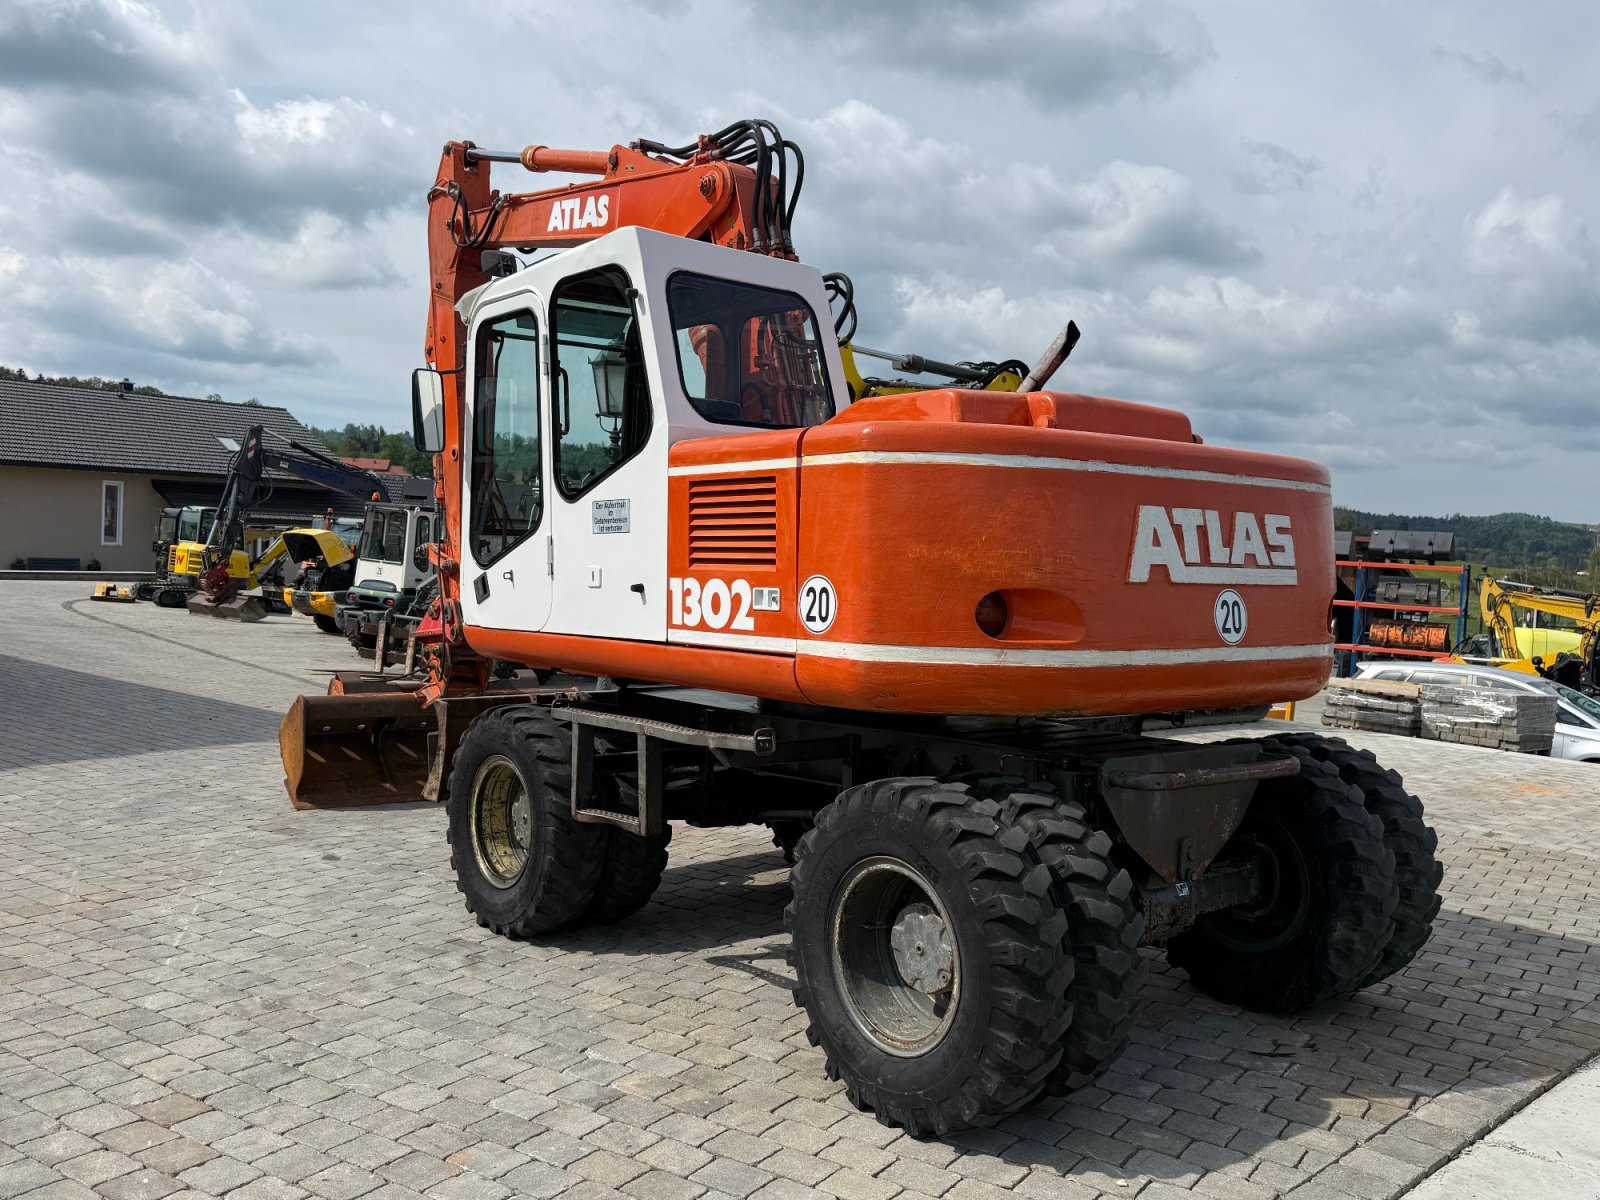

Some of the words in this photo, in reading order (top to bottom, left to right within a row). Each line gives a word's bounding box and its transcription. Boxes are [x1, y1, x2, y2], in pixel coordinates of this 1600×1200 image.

[546, 194, 610, 232] ATLAS
[1128, 504, 1298, 585] ATLAS
[669, 577, 755, 630] 1302
[805, 586, 830, 623] 20
[1220, 599, 1243, 634] 20
